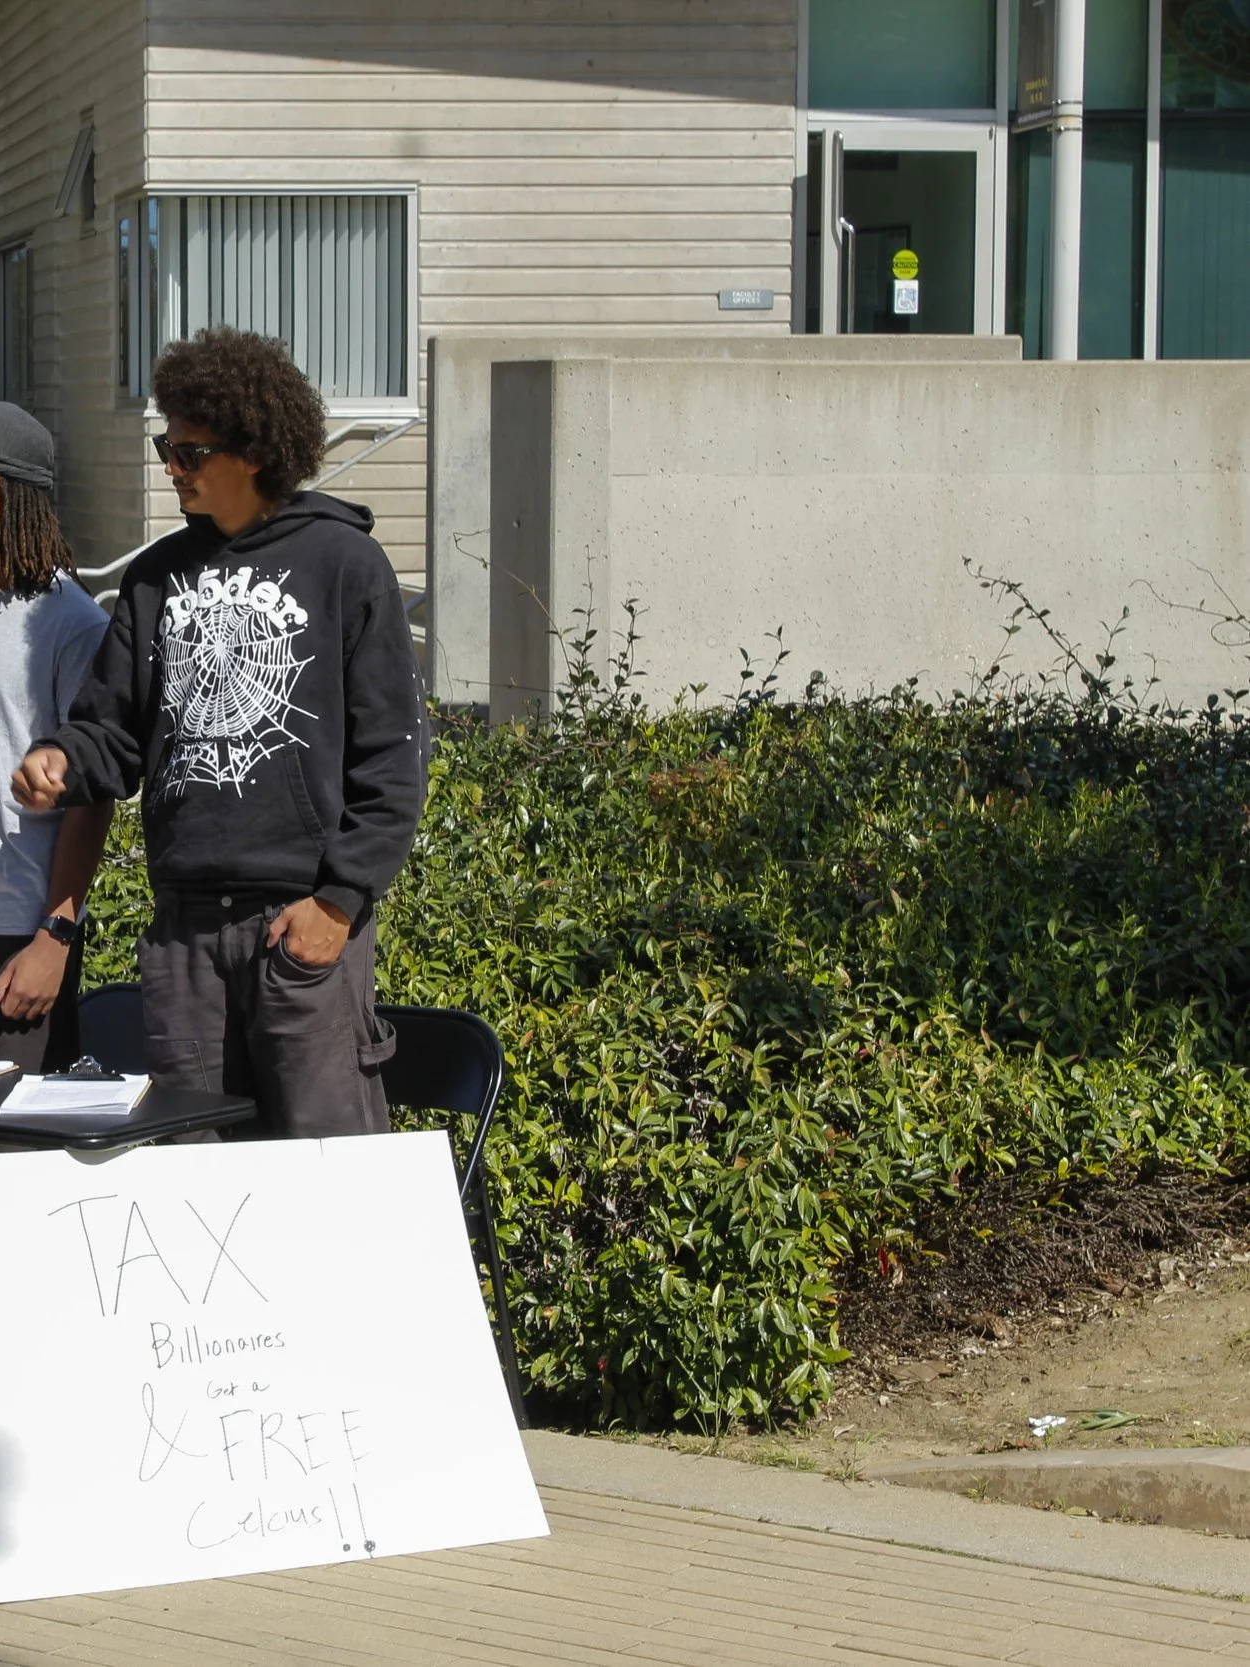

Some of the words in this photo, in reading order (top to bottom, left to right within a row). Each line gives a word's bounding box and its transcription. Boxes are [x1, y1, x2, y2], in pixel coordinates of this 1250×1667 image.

[47, 1192, 269, 1317] TAX
[150, 1322, 285, 1369] Billionaires
[252, 1381, 271, 1392] a
[139, 1382, 209, 1482] &
[219, 1409, 370, 1481] FREE
